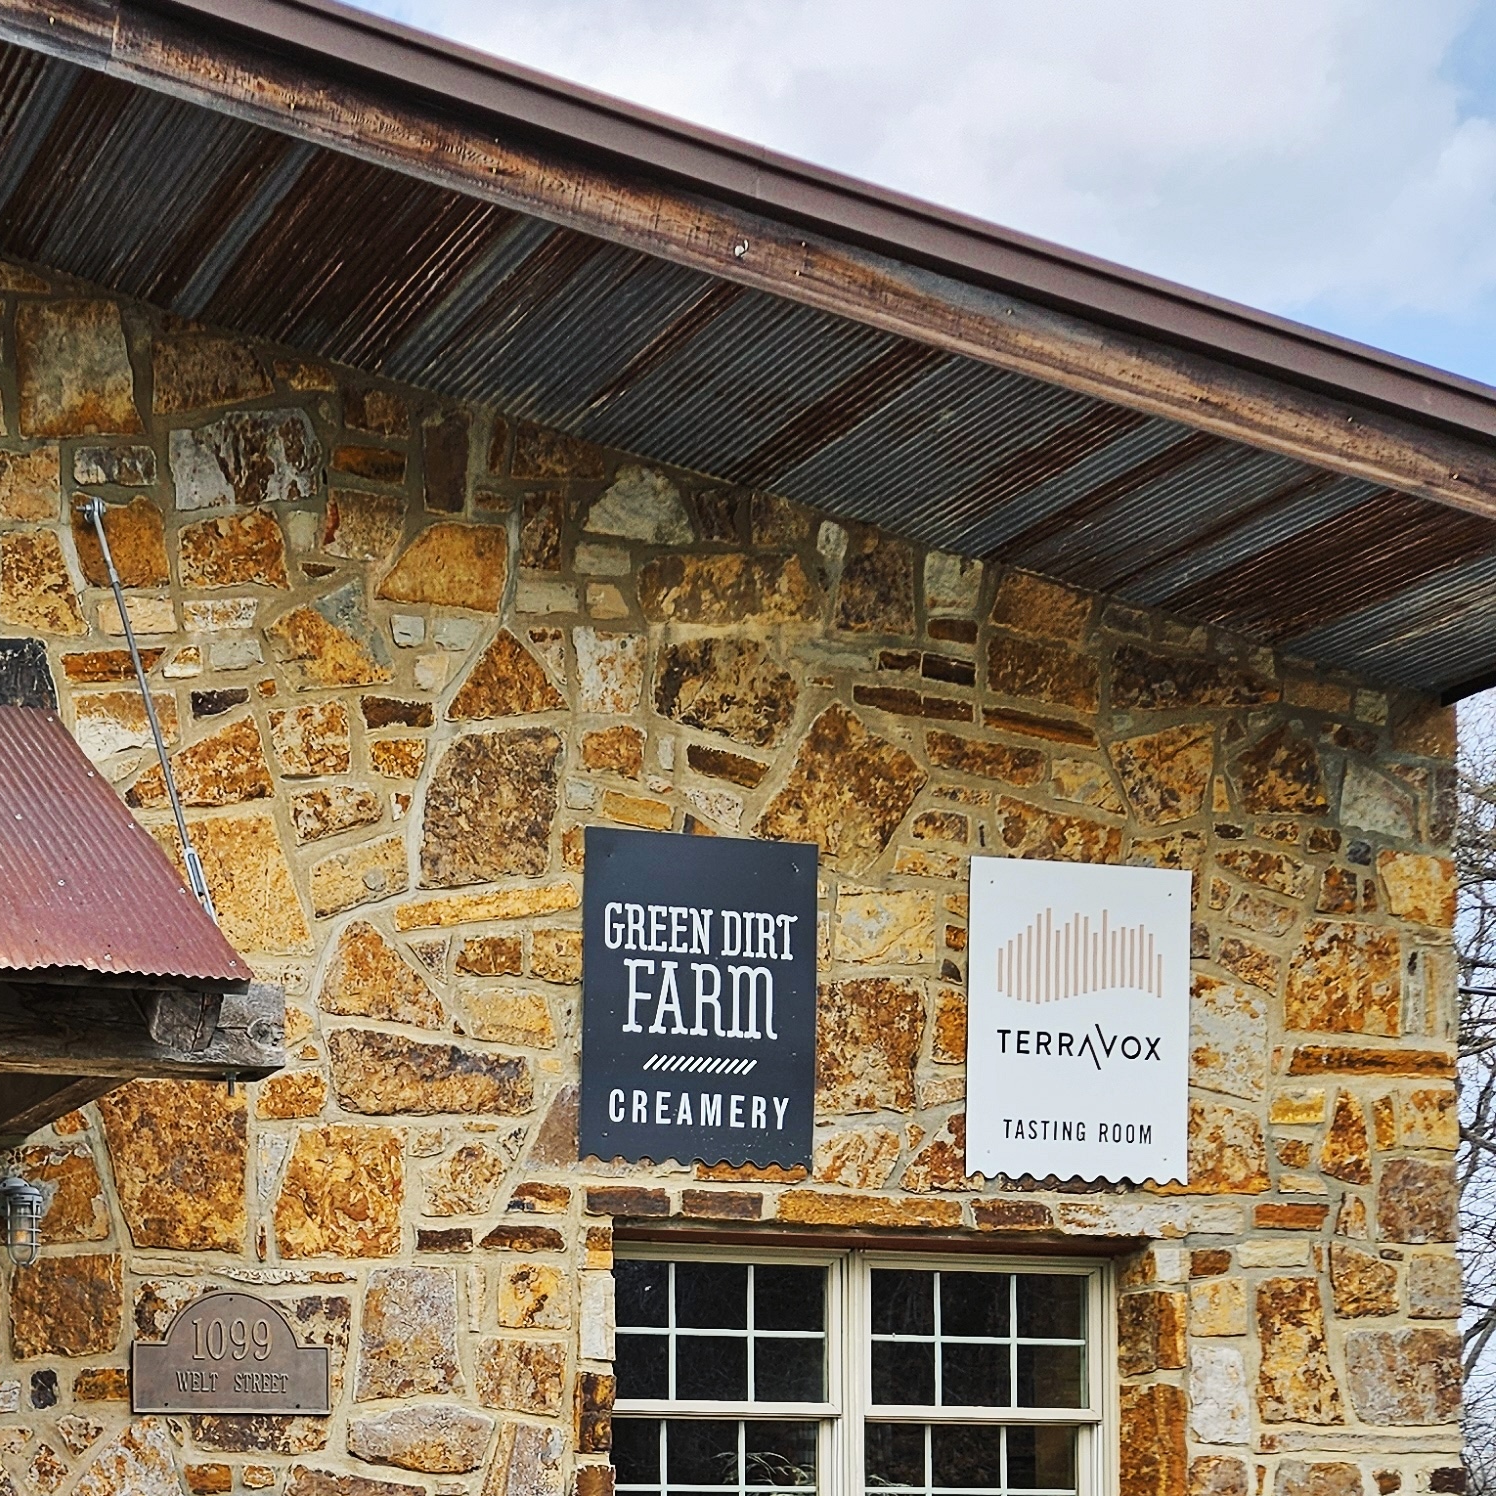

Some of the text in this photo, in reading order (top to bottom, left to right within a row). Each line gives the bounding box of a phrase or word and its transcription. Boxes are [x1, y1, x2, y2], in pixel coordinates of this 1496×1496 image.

[604, 901, 799, 961] GREEN DIRT
[622, 958, 778, 1040] FARM
[997, 1023, 1161, 1070] TERRAVOX
[608, 1088, 790, 1130] CREAMERY
[1003, 1118, 1152, 1145] TASTING ROOM
[191, 1317, 273, 1361] 1099
[176, 1370, 290, 1394] WELT STREET
